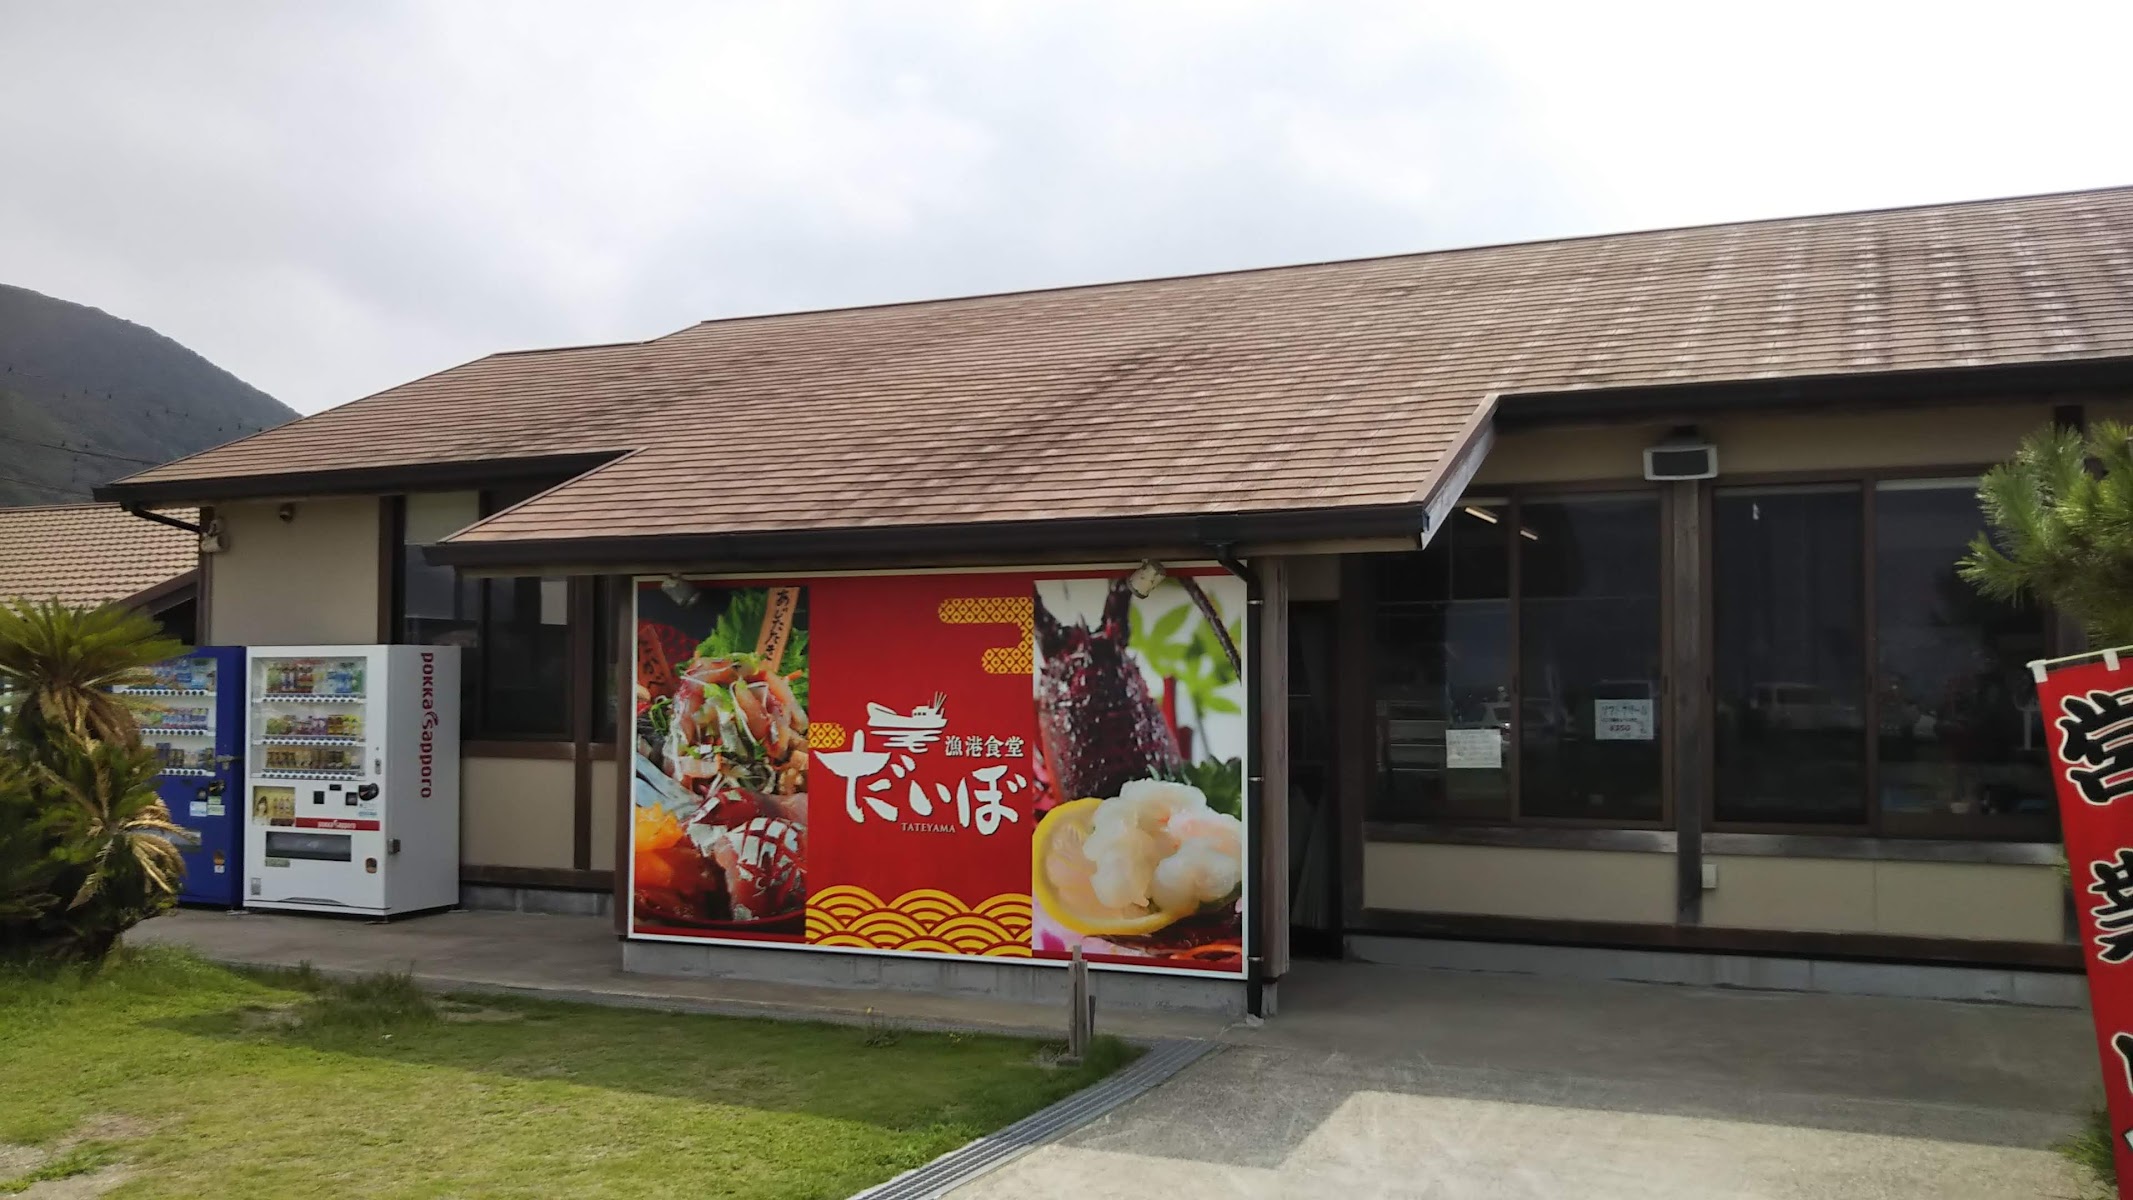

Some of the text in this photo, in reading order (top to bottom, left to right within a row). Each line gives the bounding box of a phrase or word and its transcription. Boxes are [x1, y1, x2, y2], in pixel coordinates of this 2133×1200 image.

[765, 589, 790, 661] あじたたき
[945, 735, 1024, 758] 漁港食堂
[814, 729, 1027, 836] だいぼ
[901, 822, 956, 833] TATEYAMA
